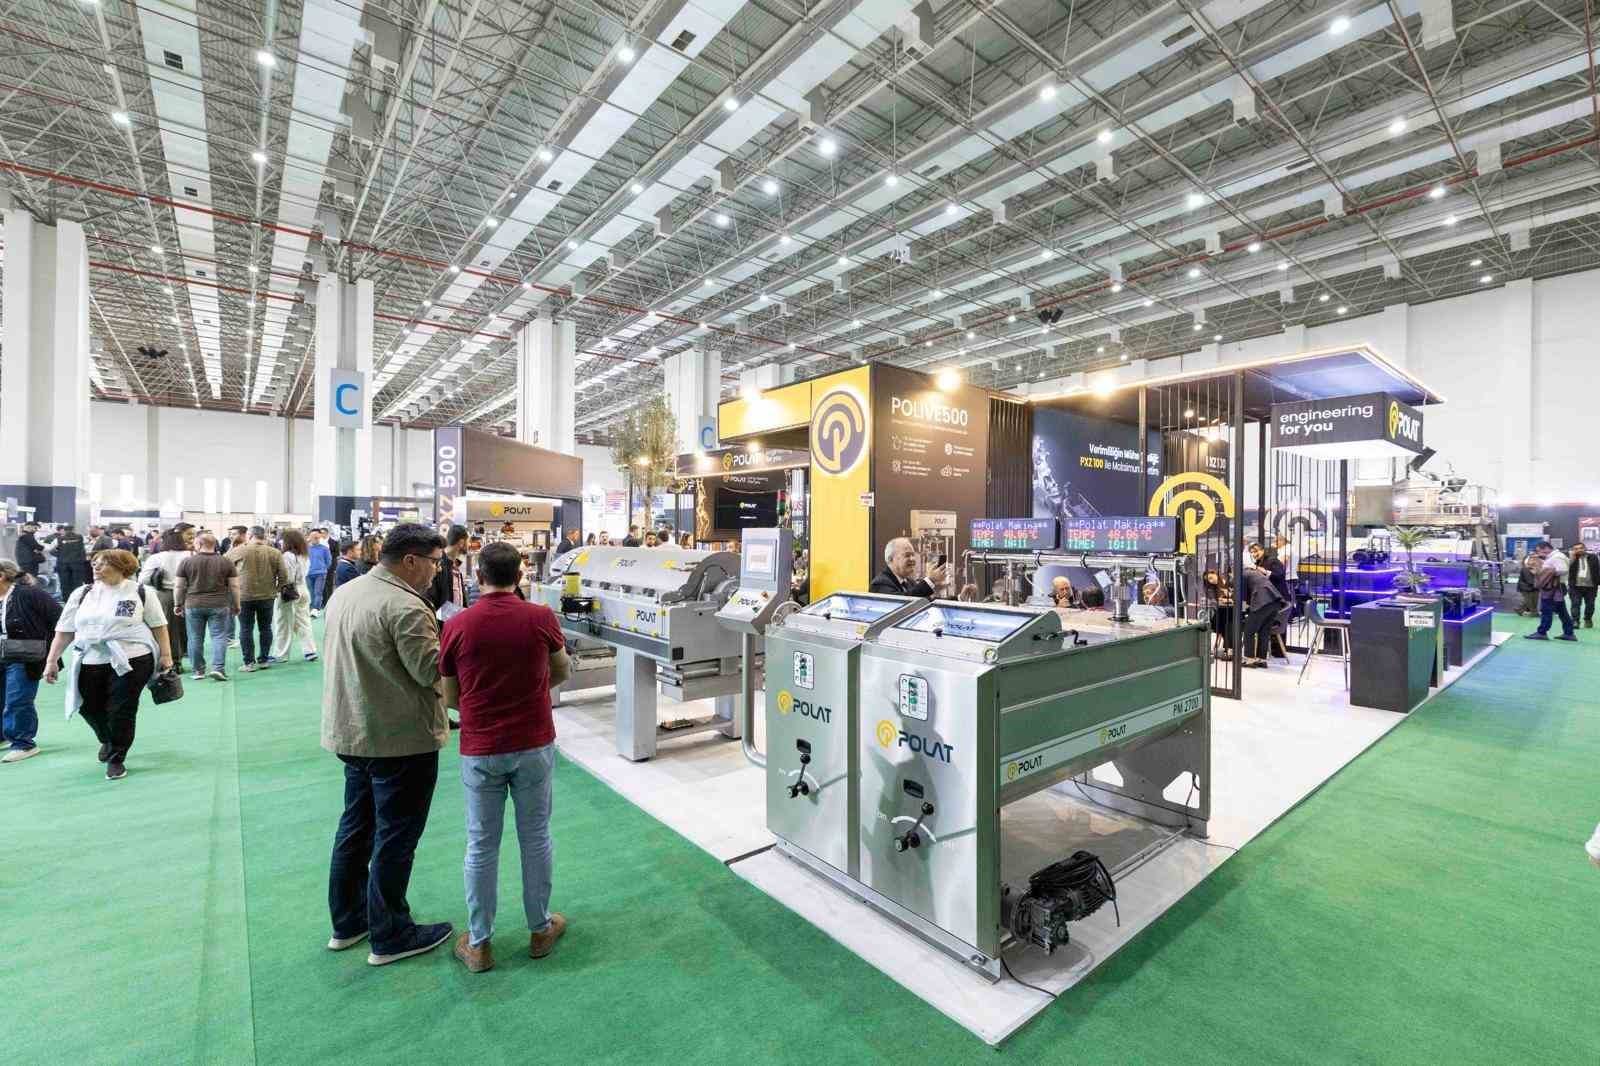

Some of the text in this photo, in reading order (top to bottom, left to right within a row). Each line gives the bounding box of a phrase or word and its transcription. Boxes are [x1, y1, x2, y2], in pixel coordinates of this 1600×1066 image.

[336, 384, 359, 415] C
[891, 396, 968, 427] POLIVE500
[1279, 405, 1374, 425] engineering
[1279, 422, 1334, 437] for you
[1398, 412, 1420, 442] POLAT
[439, 445, 457, 488] 500
[503, 506, 532, 515] POLAT
[636, 609, 657, 624] POLAT
[793, 699, 832, 723] POLAT
[1108, 723, 1127, 739] POLAT
[898, 730, 954, 763] POLAT
[1018, 755, 1043, 775] POLAT
